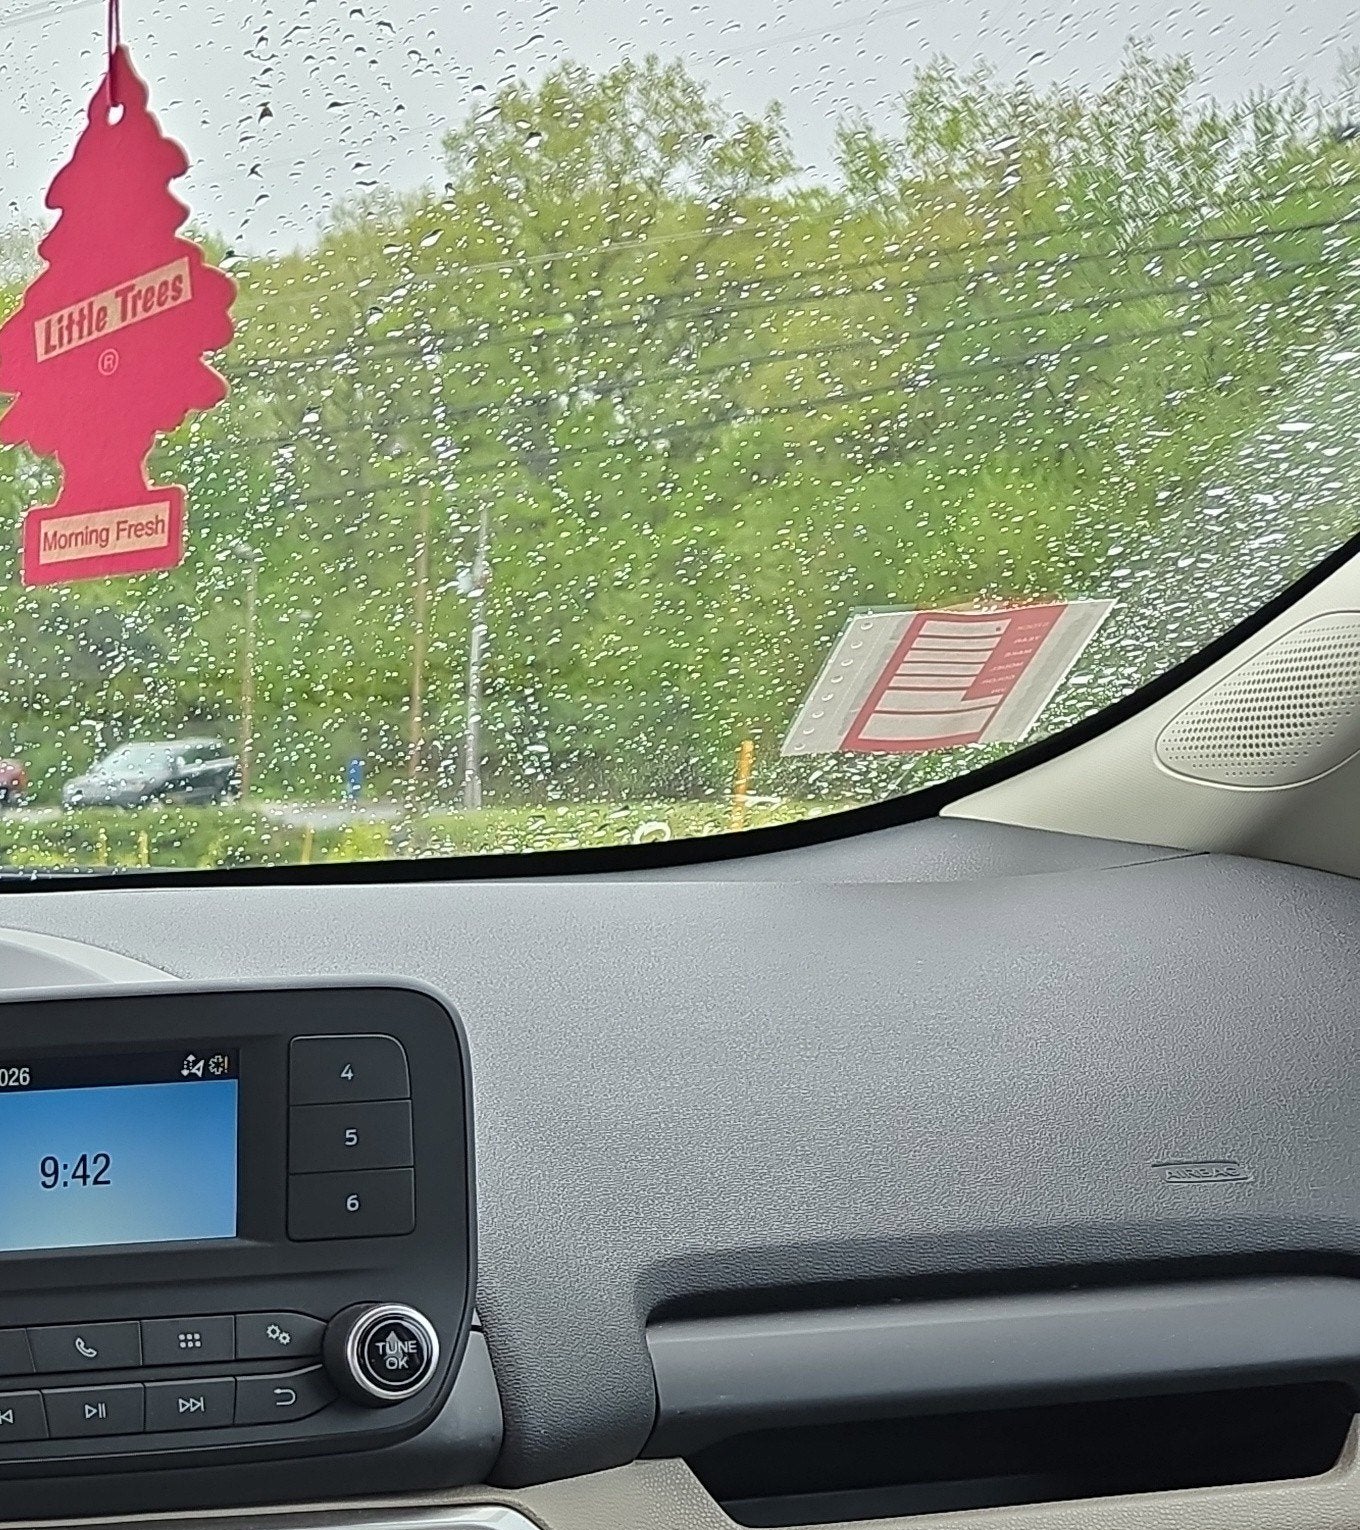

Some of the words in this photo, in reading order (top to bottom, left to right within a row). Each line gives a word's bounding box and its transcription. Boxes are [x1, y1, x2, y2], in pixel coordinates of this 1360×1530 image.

[43, 301, 108, 356] Little
[113, 272, 185, 335] Trees
[42, 522, 111, 553] Morning
[115, 514, 166, 541] Fresh
[340, 1063, 354, 1080] 4
[344, 1129, 358, 1146] 5
[39, 1152, 112, 1189] 9:42
[1166, 1166, 1241, 1180] AIRBAG
[346, 1194, 360, 1211] 6
[375, 1339, 418, 1356] TUNE
[384, 1356, 409, 1371] OK
